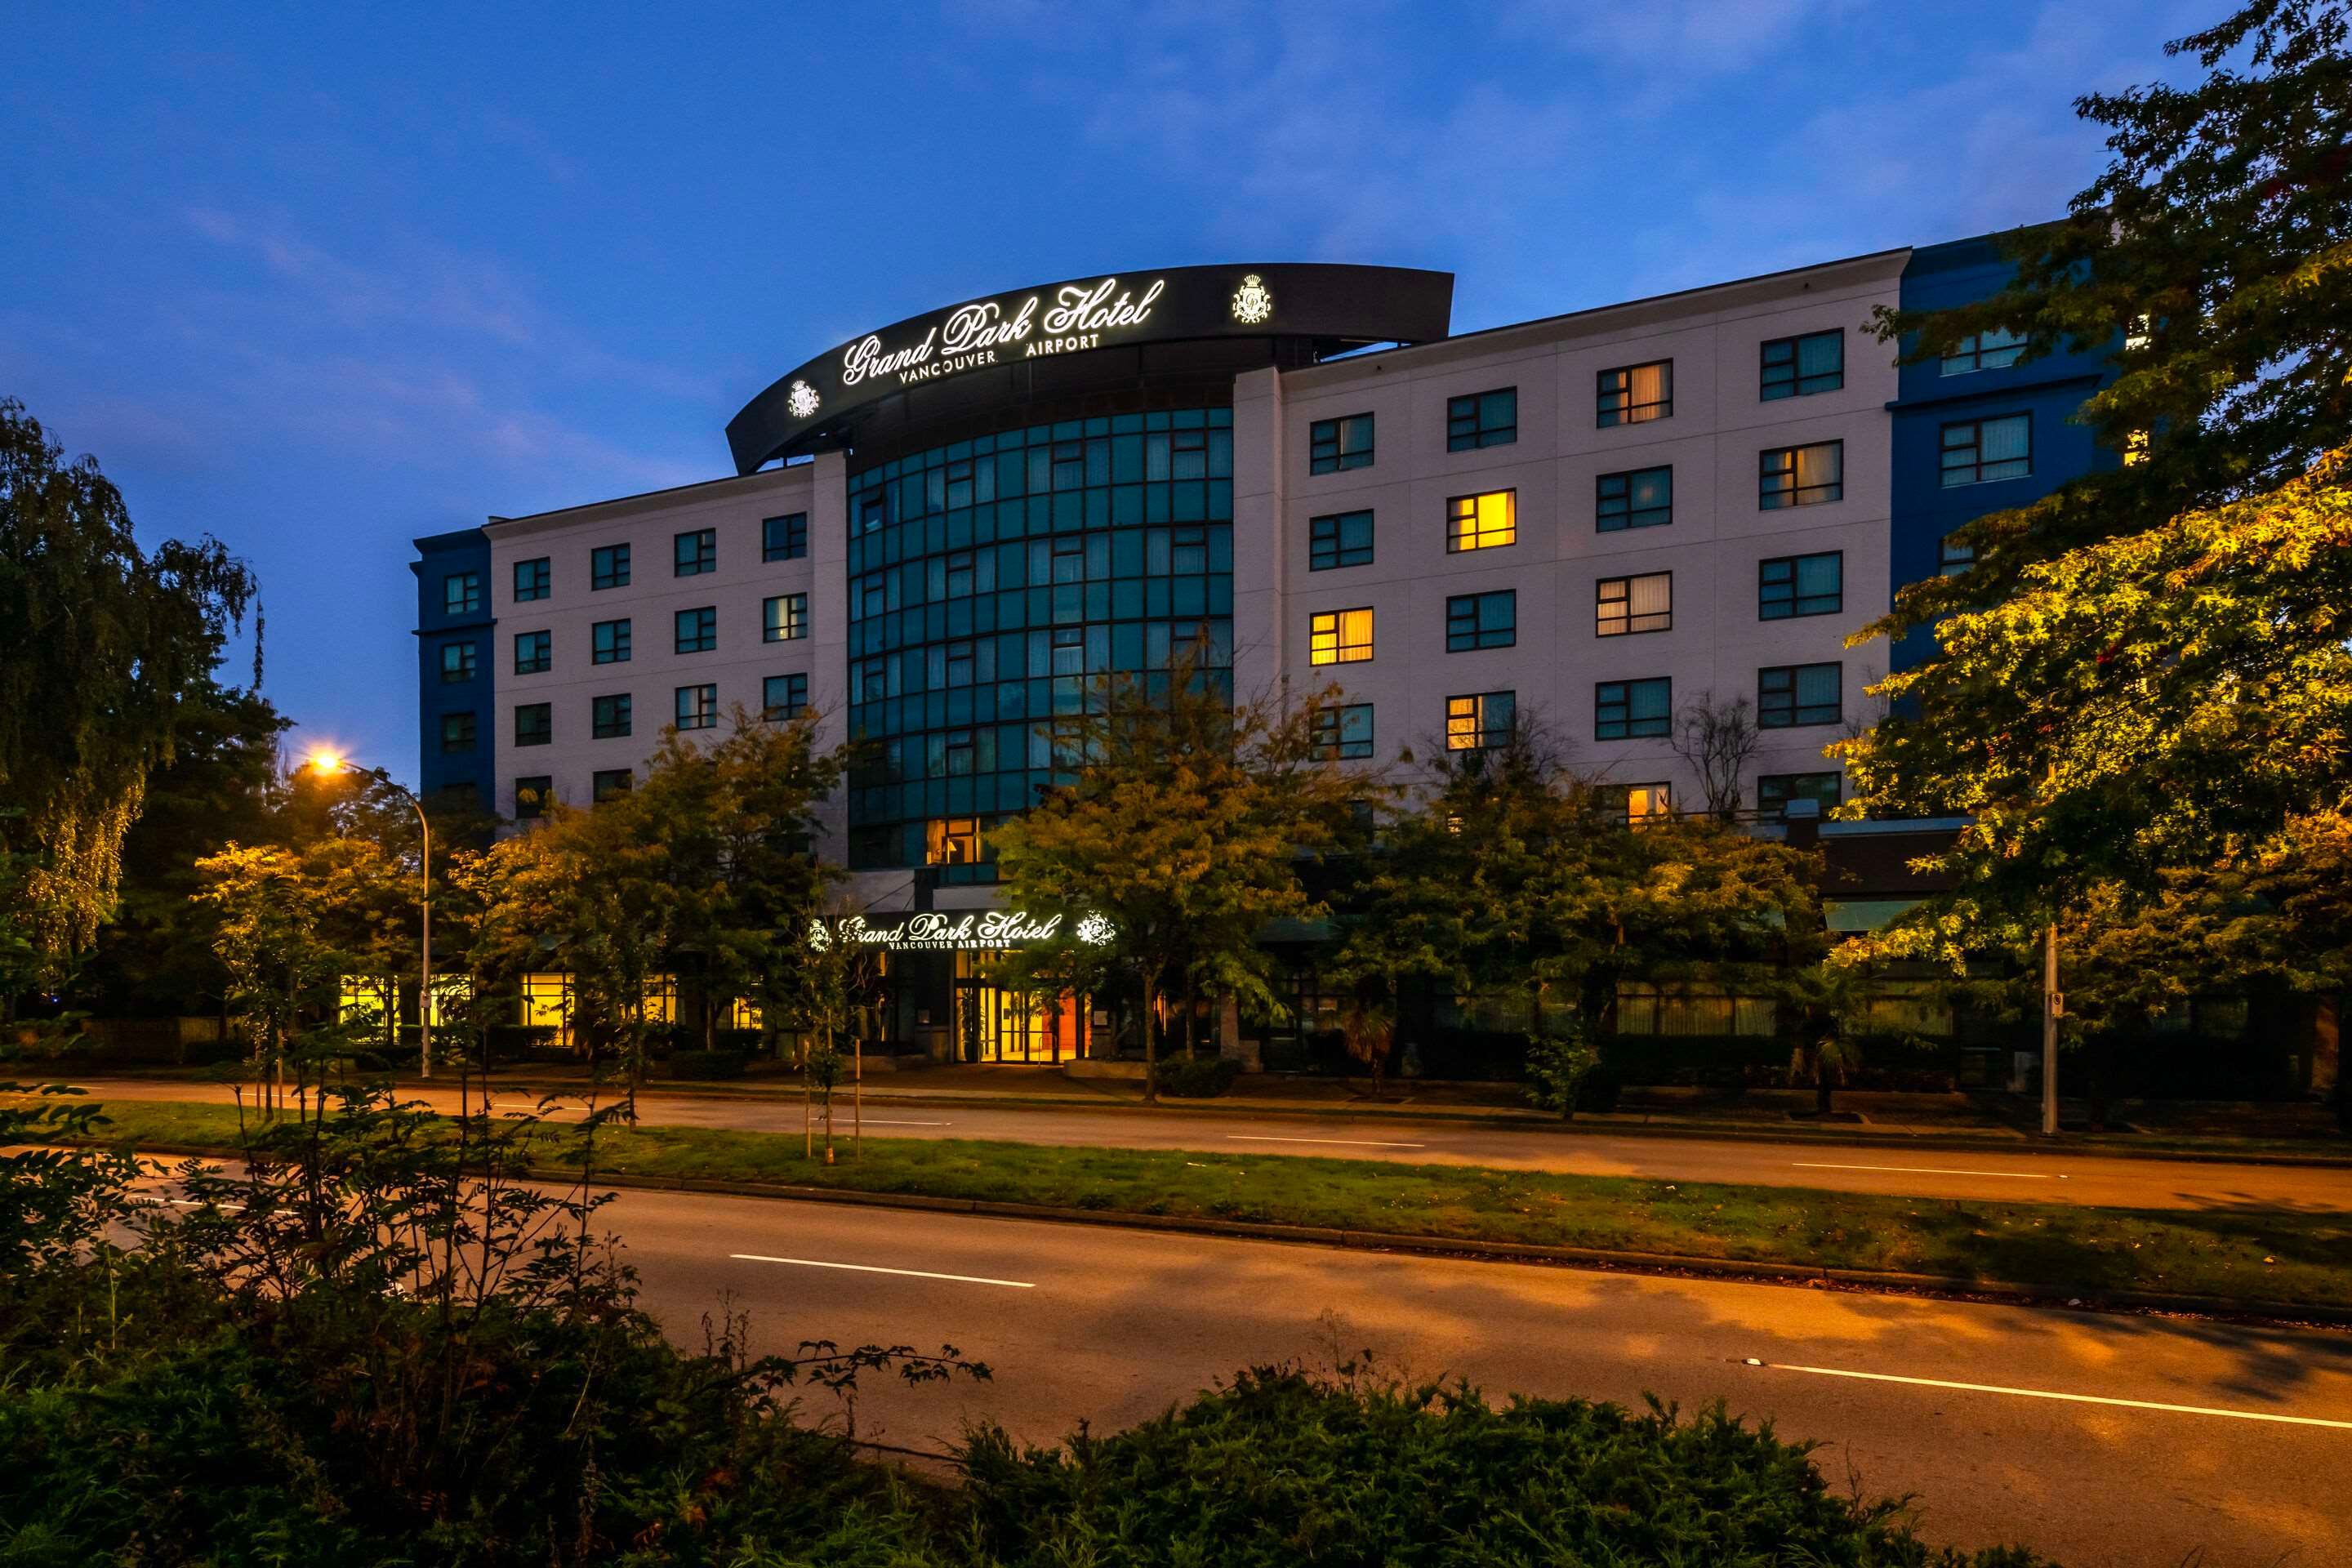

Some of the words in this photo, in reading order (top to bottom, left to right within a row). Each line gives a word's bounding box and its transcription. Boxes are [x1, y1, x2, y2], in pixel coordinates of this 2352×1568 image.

[843, 327, 938, 385] Grand
[941, 296, 1038, 354] Park
[1044, 278, 1165, 334] Hotel
[899, 351, 996, 384] VANCOUVER
[1025, 333, 1099, 357] AIRPORT
[889, 939, 954, 950] VANCOUVER
[957, 939, 1011, 949] AIRPORT
[908, 913, 975, 941] Park
[978, 911, 1062, 940] Hotel
